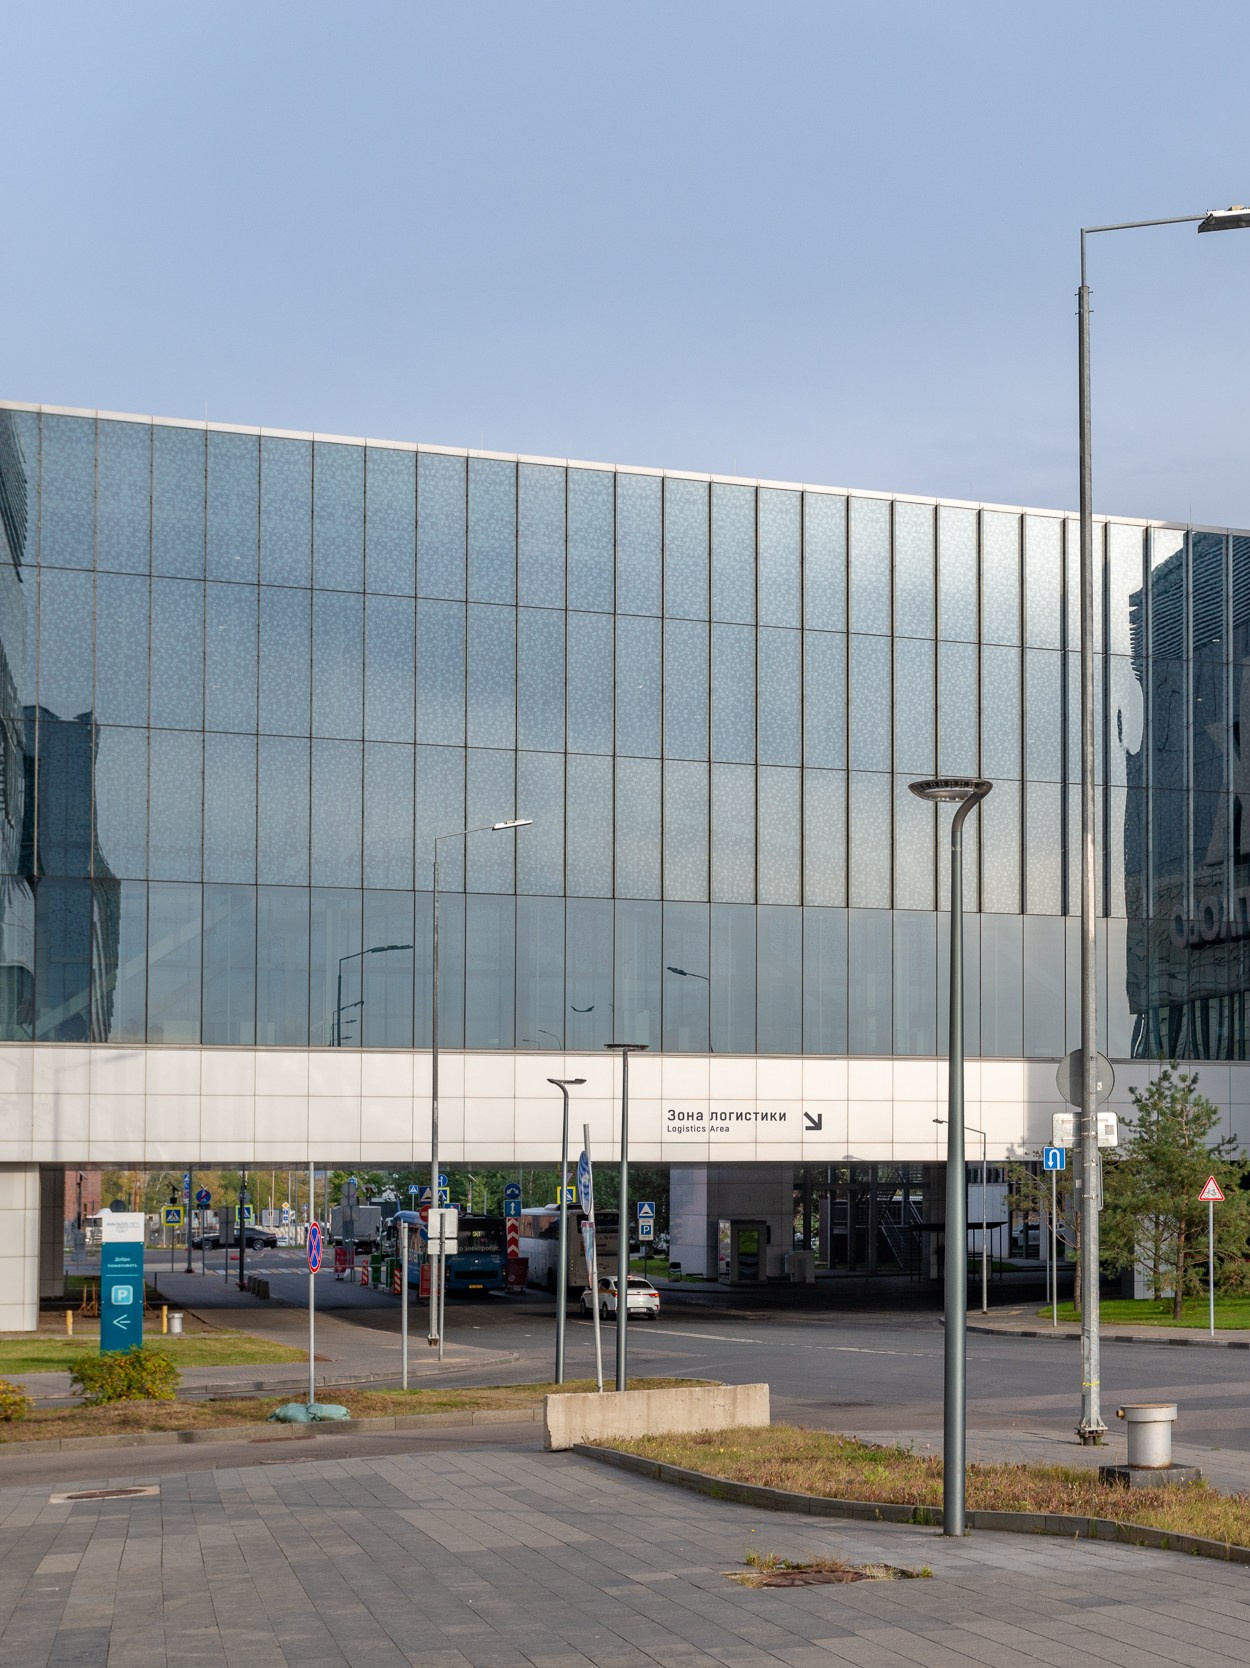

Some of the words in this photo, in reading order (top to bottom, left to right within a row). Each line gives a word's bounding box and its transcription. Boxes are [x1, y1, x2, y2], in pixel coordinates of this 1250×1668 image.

[667, 1109, 704, 1122] Зона
[709, 1111, 787, 1122] логистики
[667, 1125, 706, 1134] Logistics
[709, 1125, 730, 1133] Area
[644, 1226, 650, 1235] P
[119, 1290, 128, 1302] P
